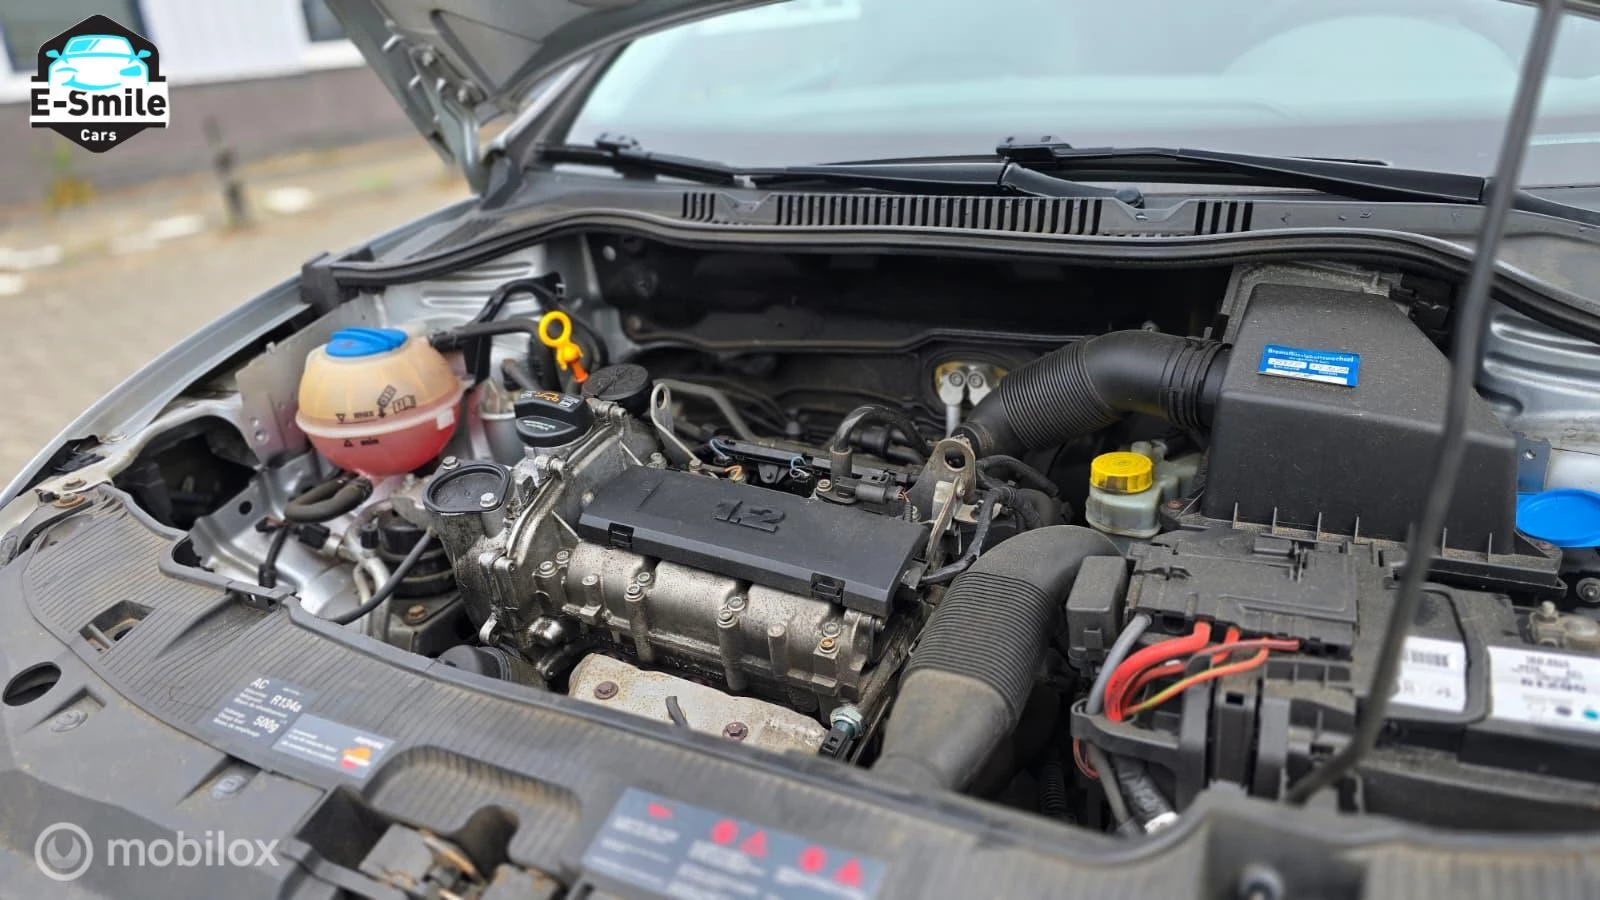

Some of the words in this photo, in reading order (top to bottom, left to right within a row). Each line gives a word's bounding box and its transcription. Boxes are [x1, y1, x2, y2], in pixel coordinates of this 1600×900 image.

[250, 677, 270, 690] AC
[270, 695, 303, 713] R134a
[253, 715, 281, 734] 500g
